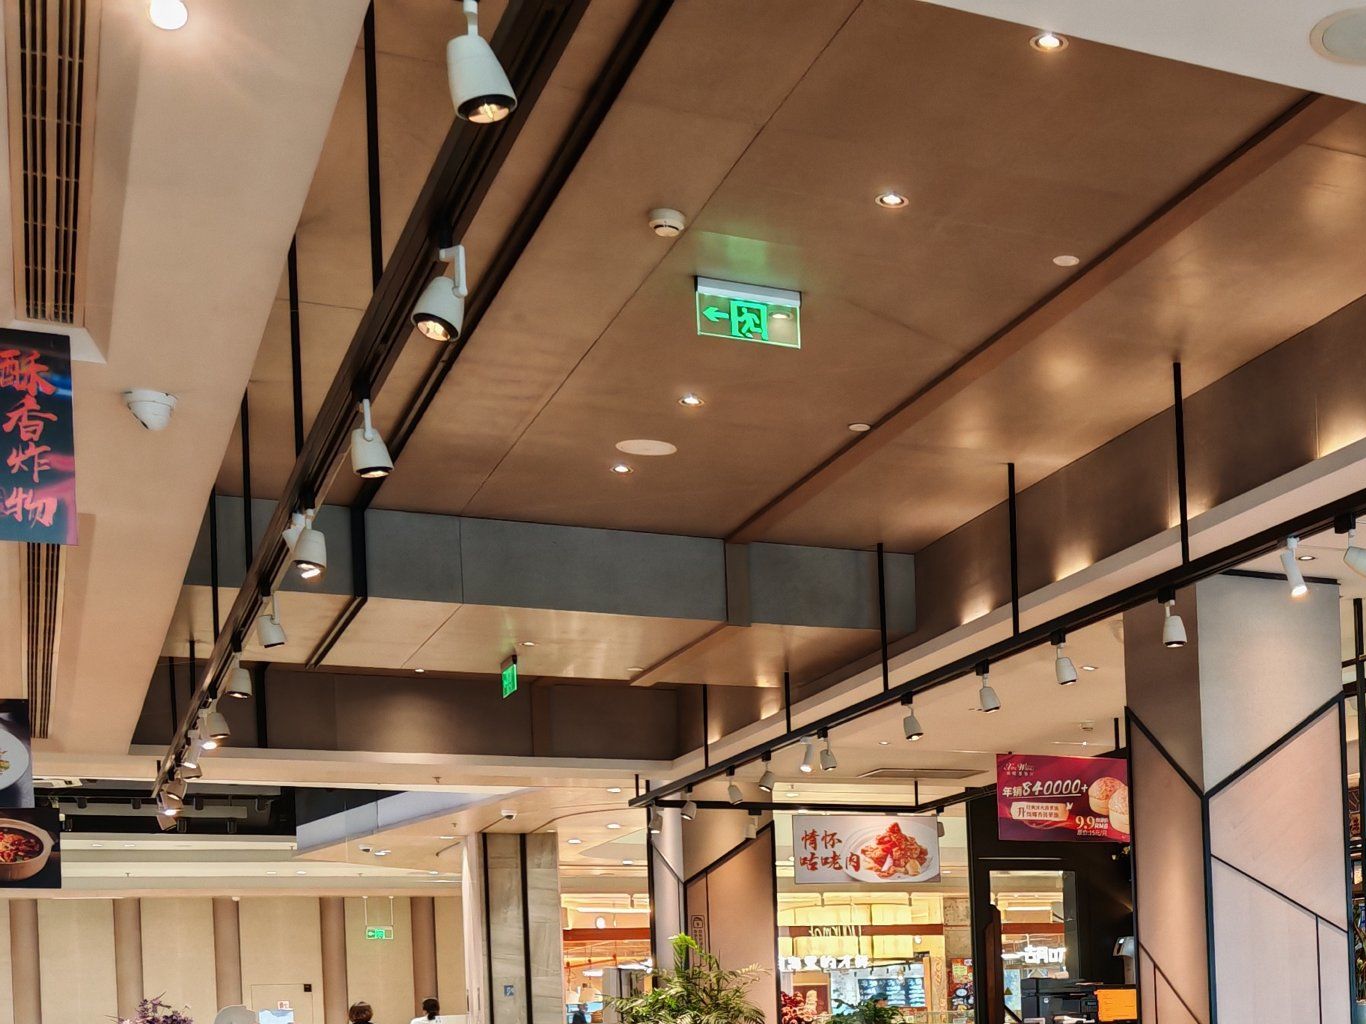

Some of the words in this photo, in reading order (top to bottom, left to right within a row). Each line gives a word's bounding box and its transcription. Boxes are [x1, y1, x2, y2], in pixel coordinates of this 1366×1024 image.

[0, 349, 57, 527] 酥香炸物
[801, 829, 842, 851] 情怀
